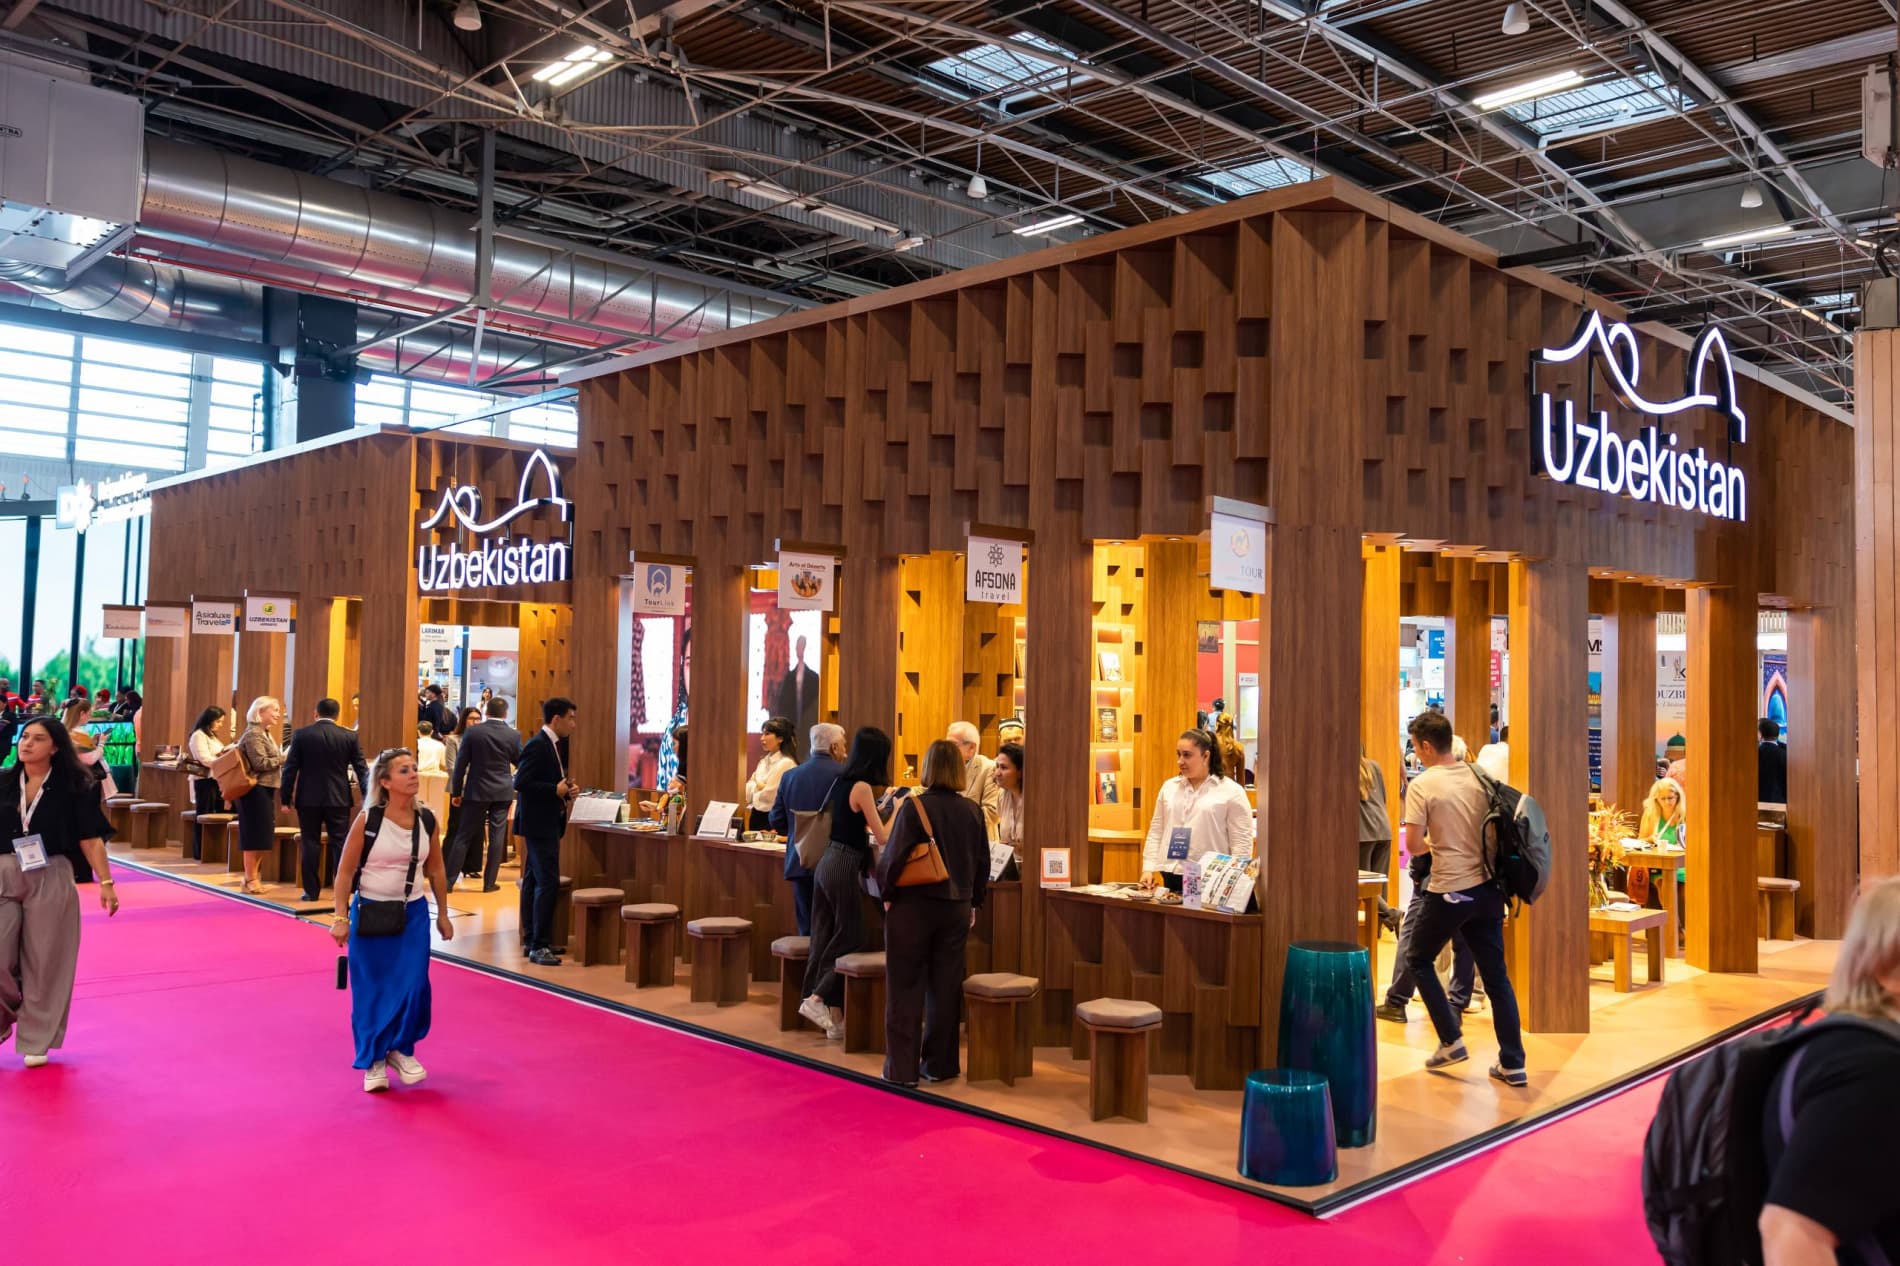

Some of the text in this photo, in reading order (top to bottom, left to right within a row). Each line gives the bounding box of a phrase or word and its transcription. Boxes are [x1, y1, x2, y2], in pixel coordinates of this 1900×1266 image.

[1542, 392, 1746, 522] Uzbekistan
[418, 537, 567, 592] Uzbekistan
[1240, 565, 1264, 580] TOUR
[975, 569, 1016, 591] AFSONA
[981, 591, 1010, 601] travel
[196, 610, 232, 619] Asialuxe
